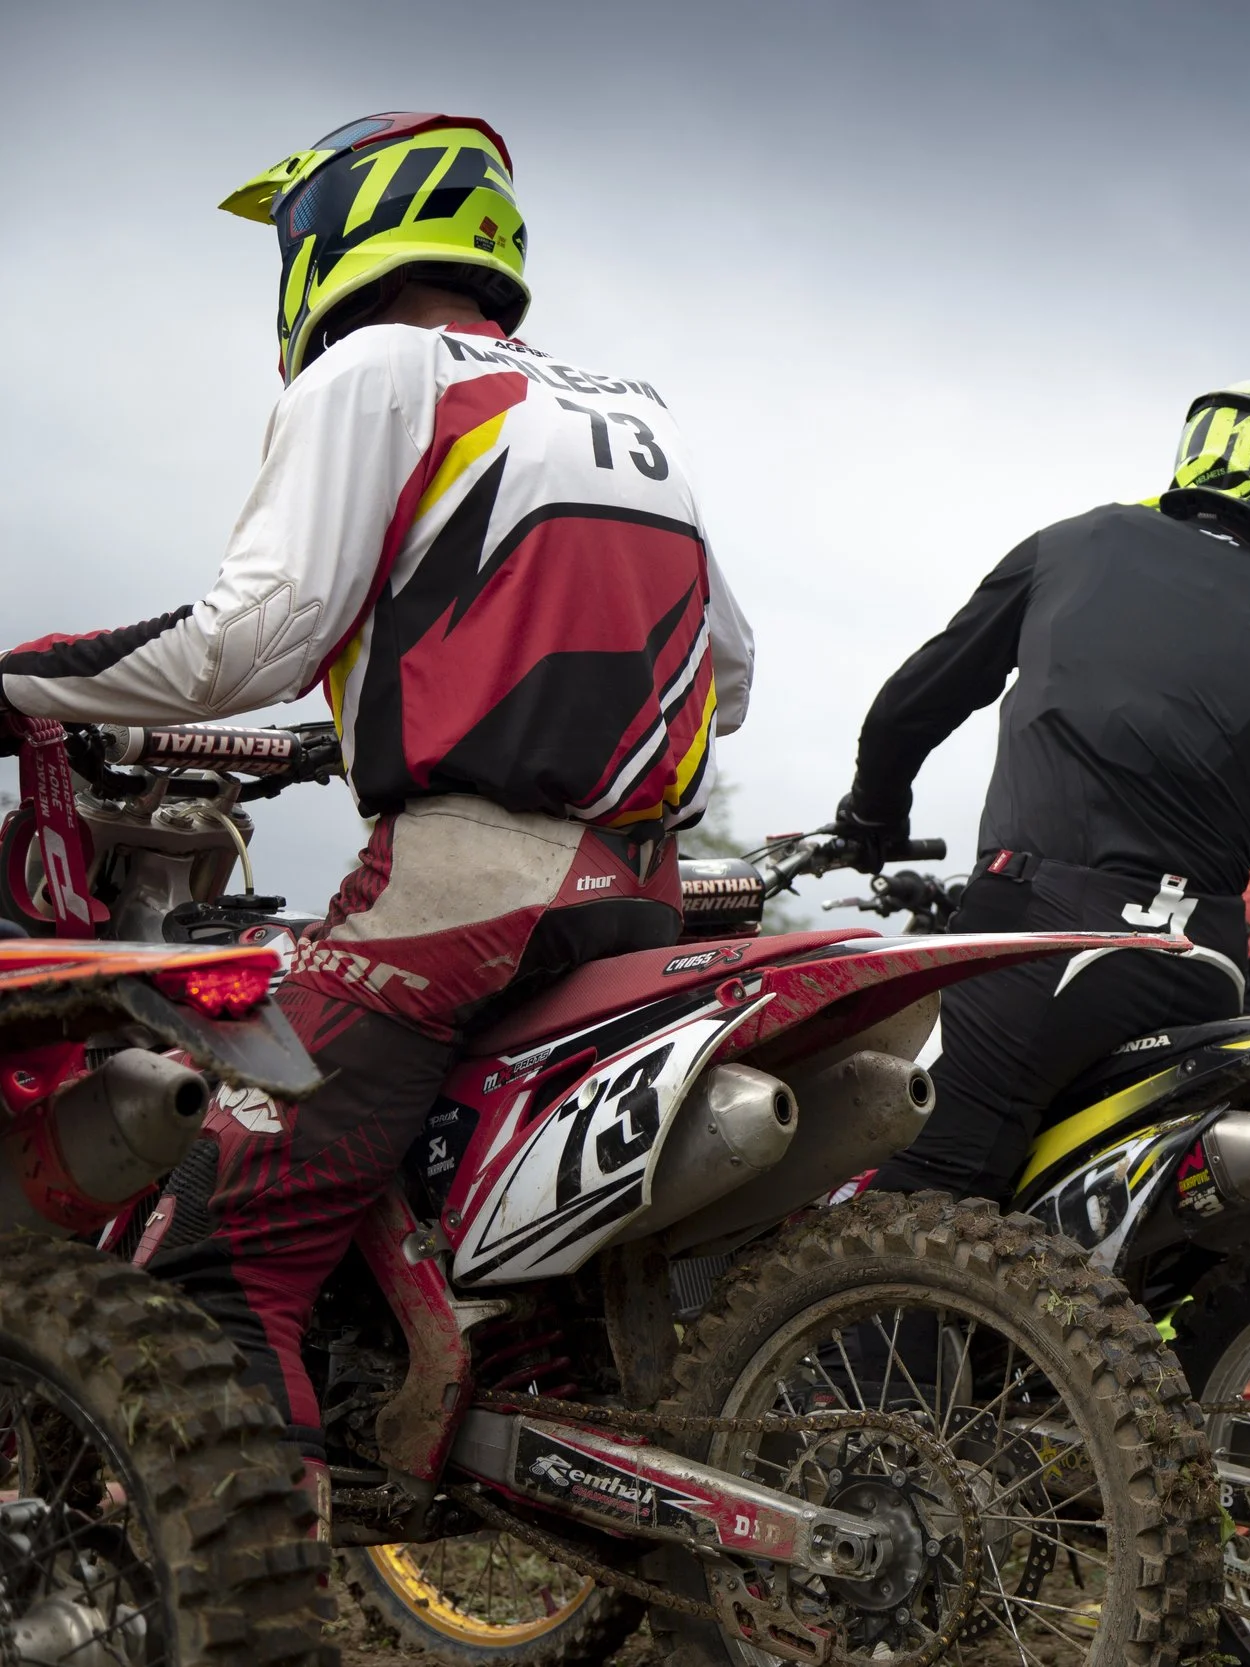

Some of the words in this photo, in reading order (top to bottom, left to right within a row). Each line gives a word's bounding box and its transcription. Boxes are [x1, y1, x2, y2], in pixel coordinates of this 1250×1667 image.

[555, 397, 669, 481] 73
[152, 732, 292, 757] RENTHAL
[577, 875, 616, 891] thor
[682, 877, 763, 895] RENTHAL
[513, 1048, 551, 1074] PARTS
[557, 1042, 675, 1210] 73
